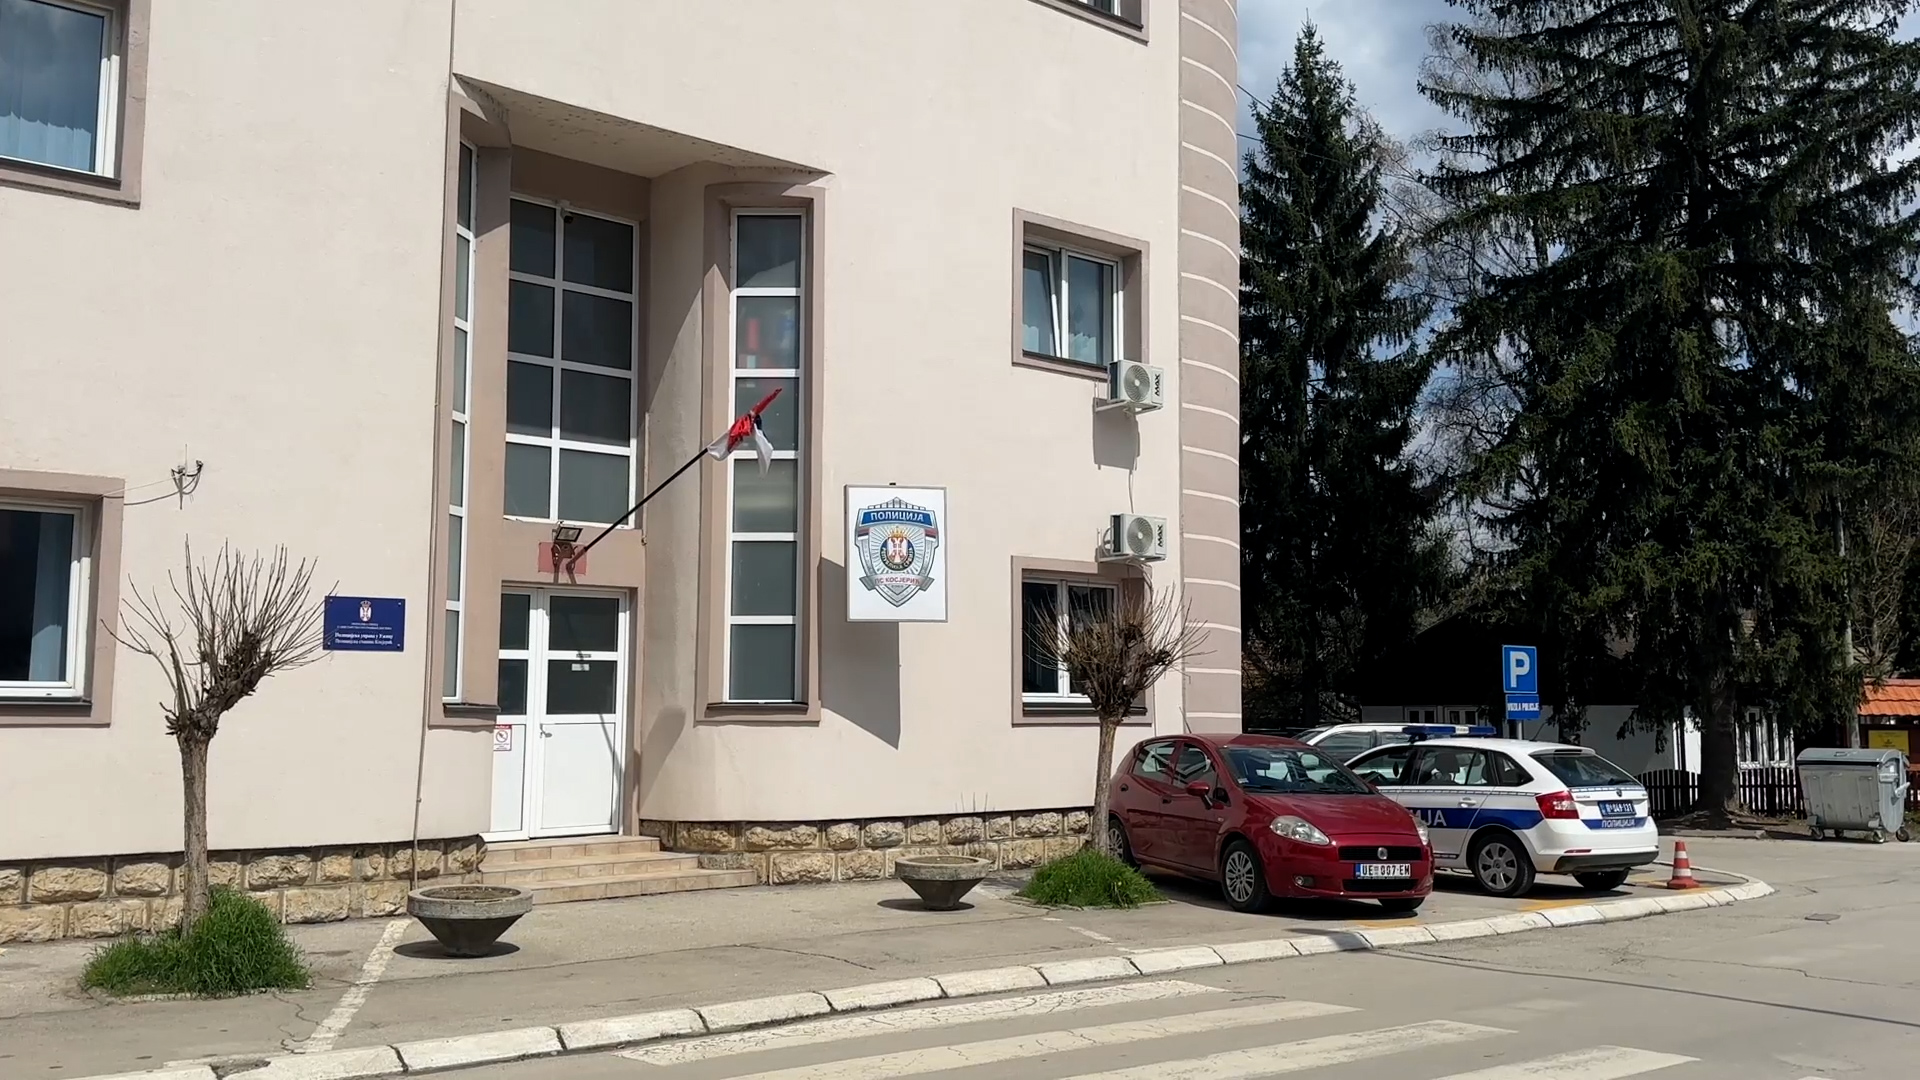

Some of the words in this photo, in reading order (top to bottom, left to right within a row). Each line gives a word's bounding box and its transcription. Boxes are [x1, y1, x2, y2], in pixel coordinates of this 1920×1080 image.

[870, 511, 924, 522] ПОЛИЦИЈА
[1510, 651, 1530, 688] P
[1601, 819, 1636, 828] ПОЛИЦИЈА
[1362, 864, 1373, 876] UE
